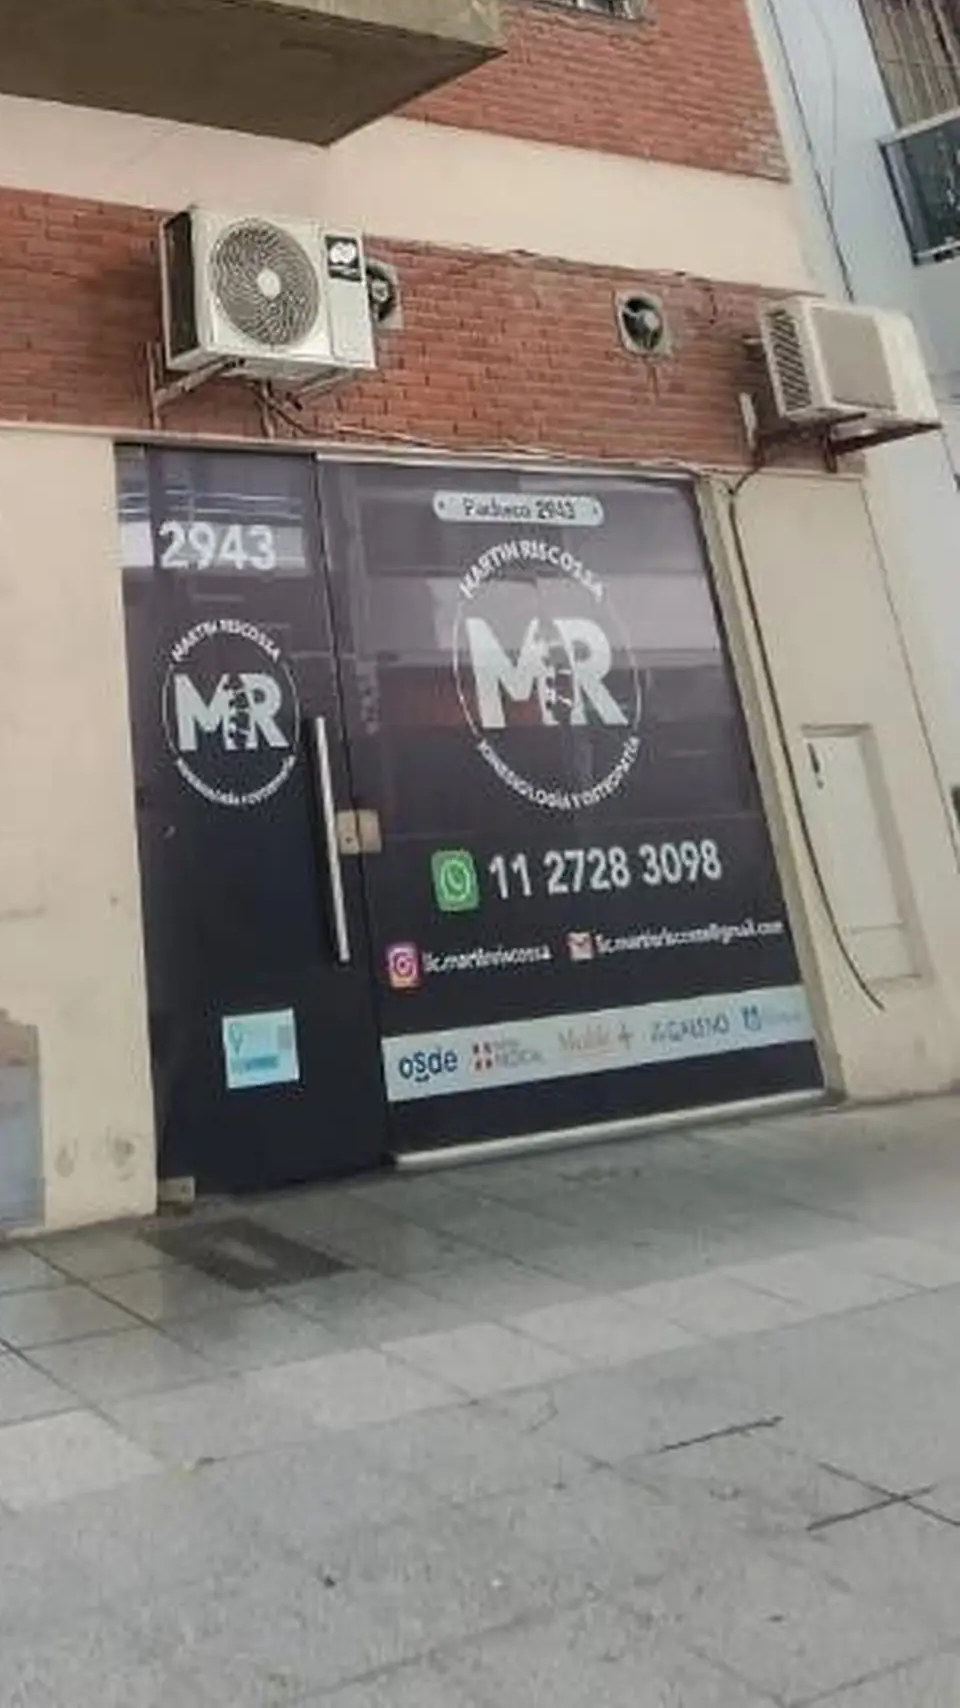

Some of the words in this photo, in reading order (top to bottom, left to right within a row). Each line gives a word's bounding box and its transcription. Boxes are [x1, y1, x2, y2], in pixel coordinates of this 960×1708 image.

[535, 498, 575, 520] 2943
[159, 520, 276, 570] 2943
[520, 539, 604, 603] RISCOSSA
[490, 854, 531, 899] 11
[544, 846, 630, 894] 2728
[640, 839, 722, 885] 3098
[399, 1045, 458, 1080] osde
